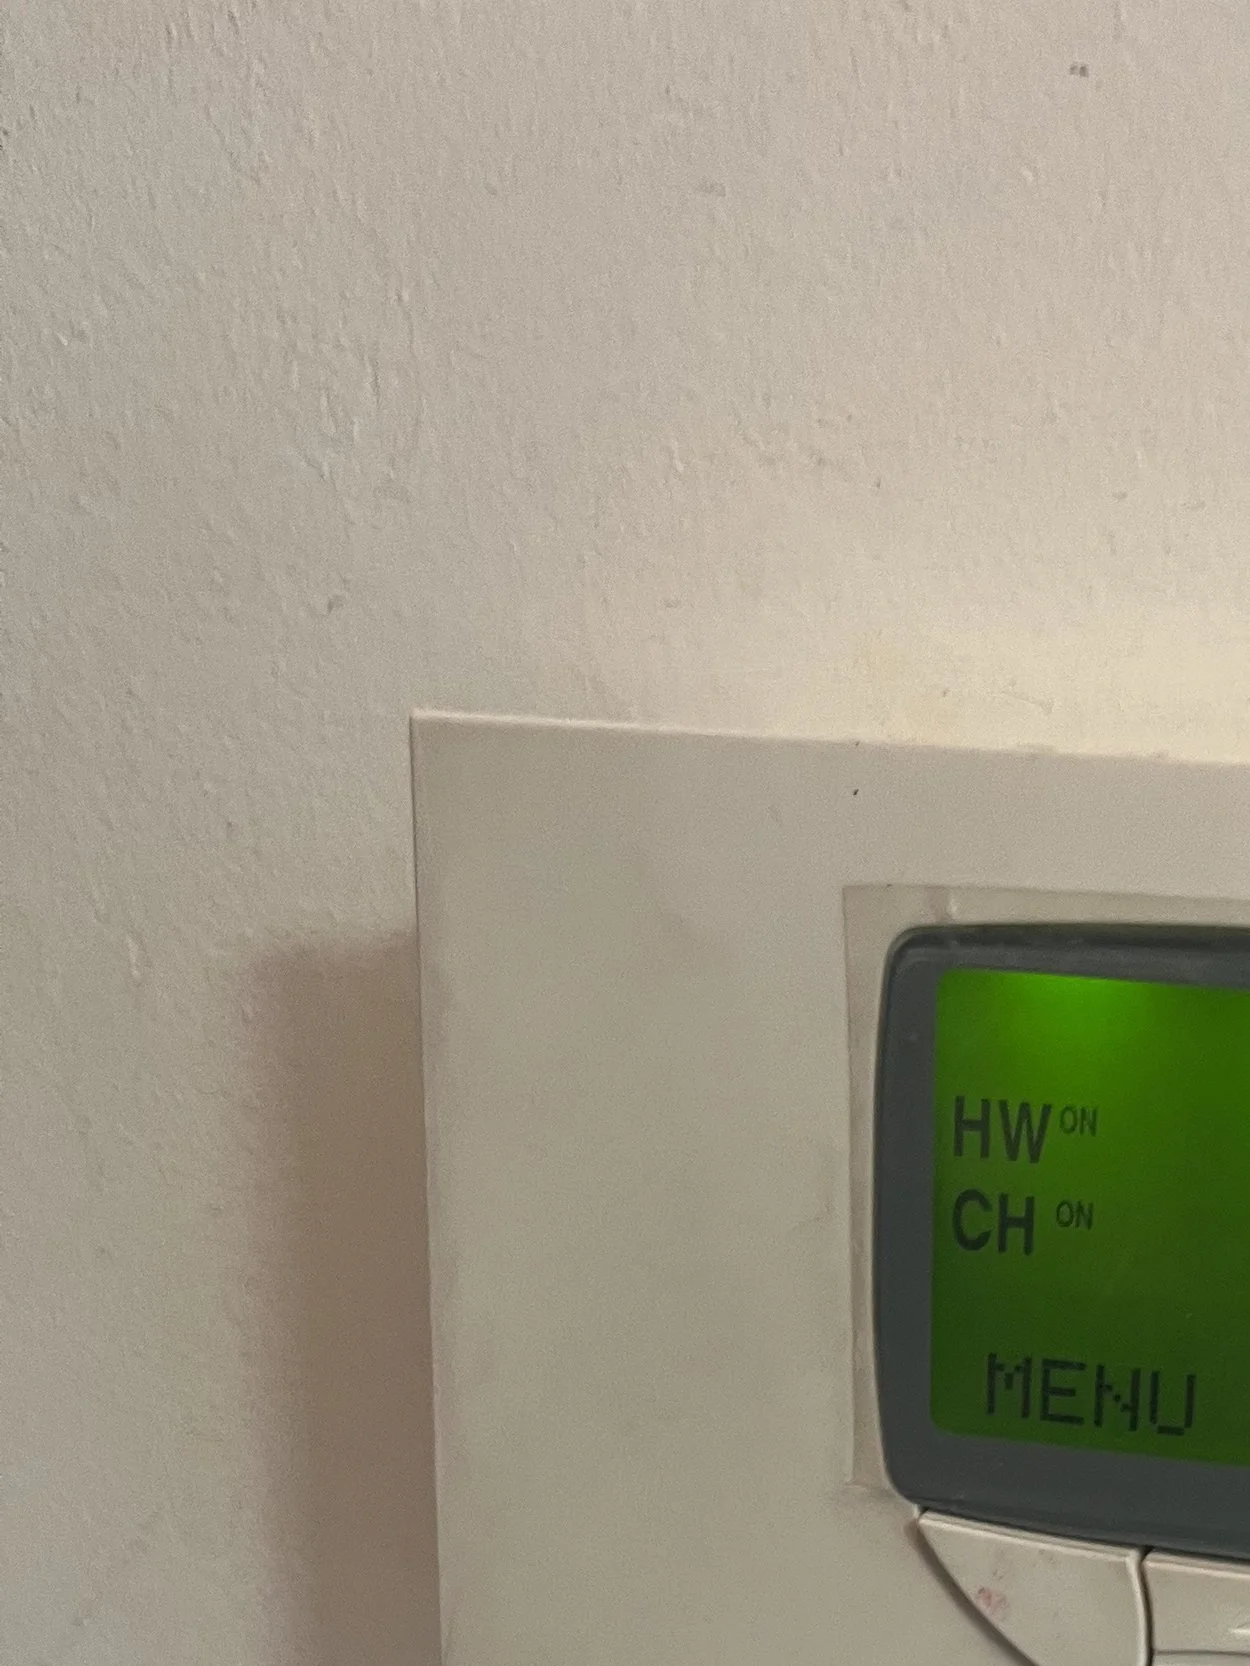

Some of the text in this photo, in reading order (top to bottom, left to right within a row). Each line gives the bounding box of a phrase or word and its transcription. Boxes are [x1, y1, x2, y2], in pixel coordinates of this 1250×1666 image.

[952, 1095, 1099, 1164] HW ON
[951, 1187, 1094, 1256] CH ON
[984, 1353, 1197, 1437] MENU
